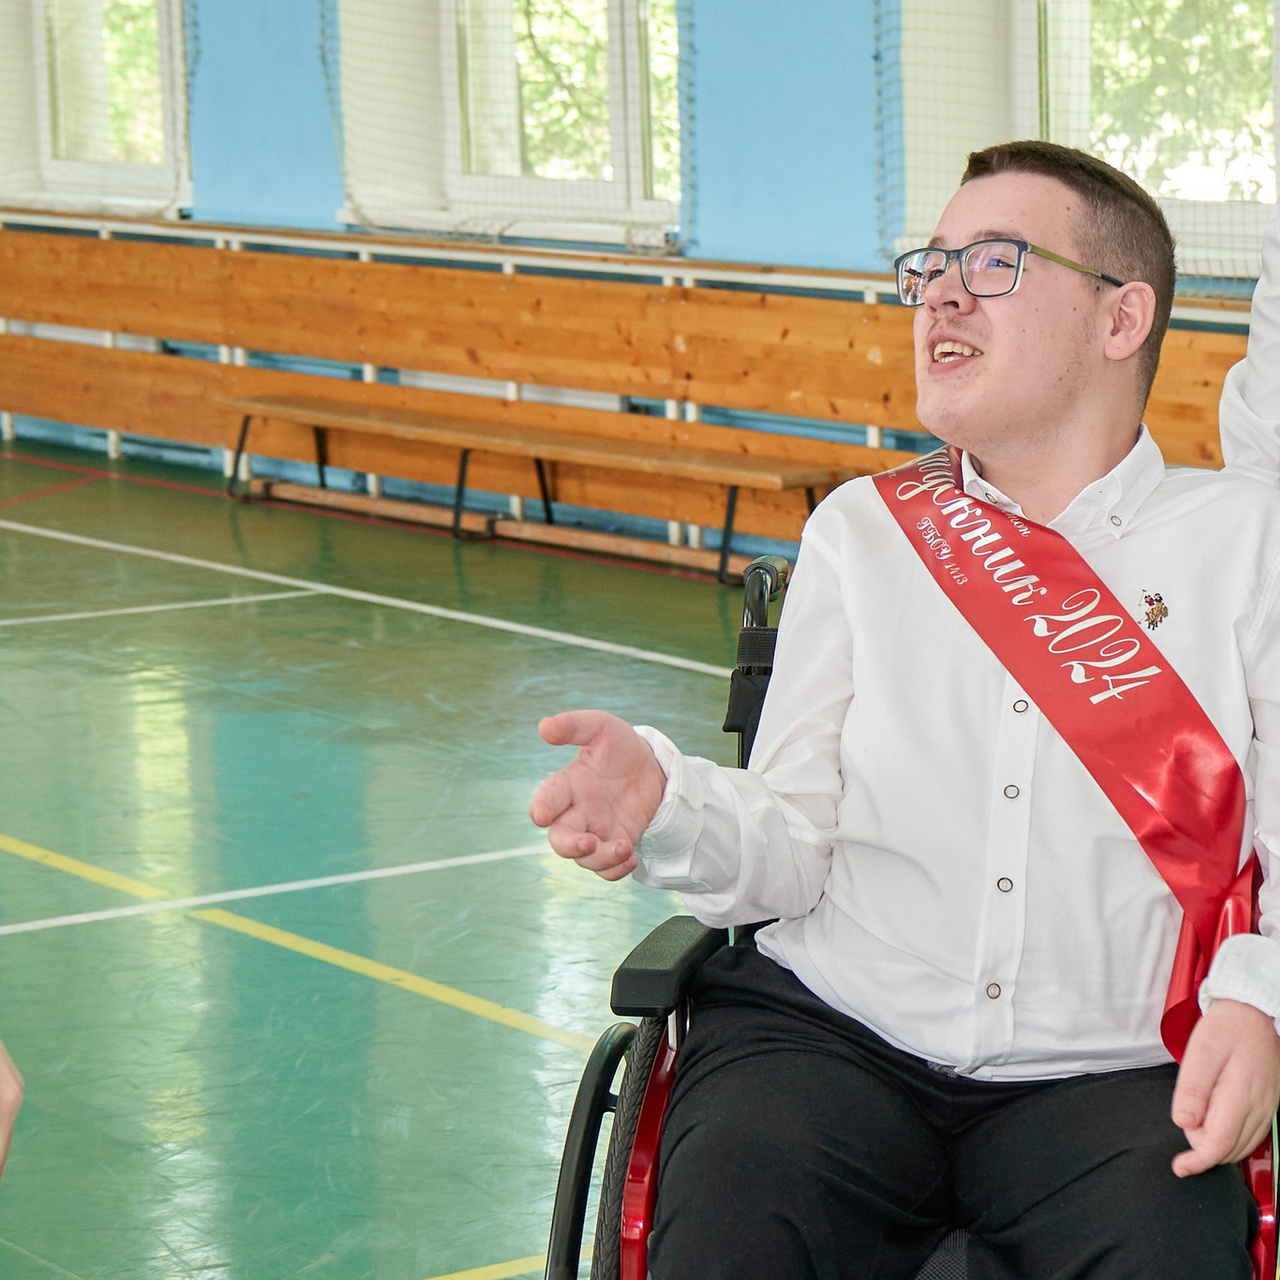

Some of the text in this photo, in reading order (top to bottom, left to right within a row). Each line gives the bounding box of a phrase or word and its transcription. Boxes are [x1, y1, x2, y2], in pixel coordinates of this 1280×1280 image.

[916, 516, 969, 586] ГБОУ 1413
[1001, 509, 1031, 538] тон
[896, 450, 1163, 705] пускник 2024
